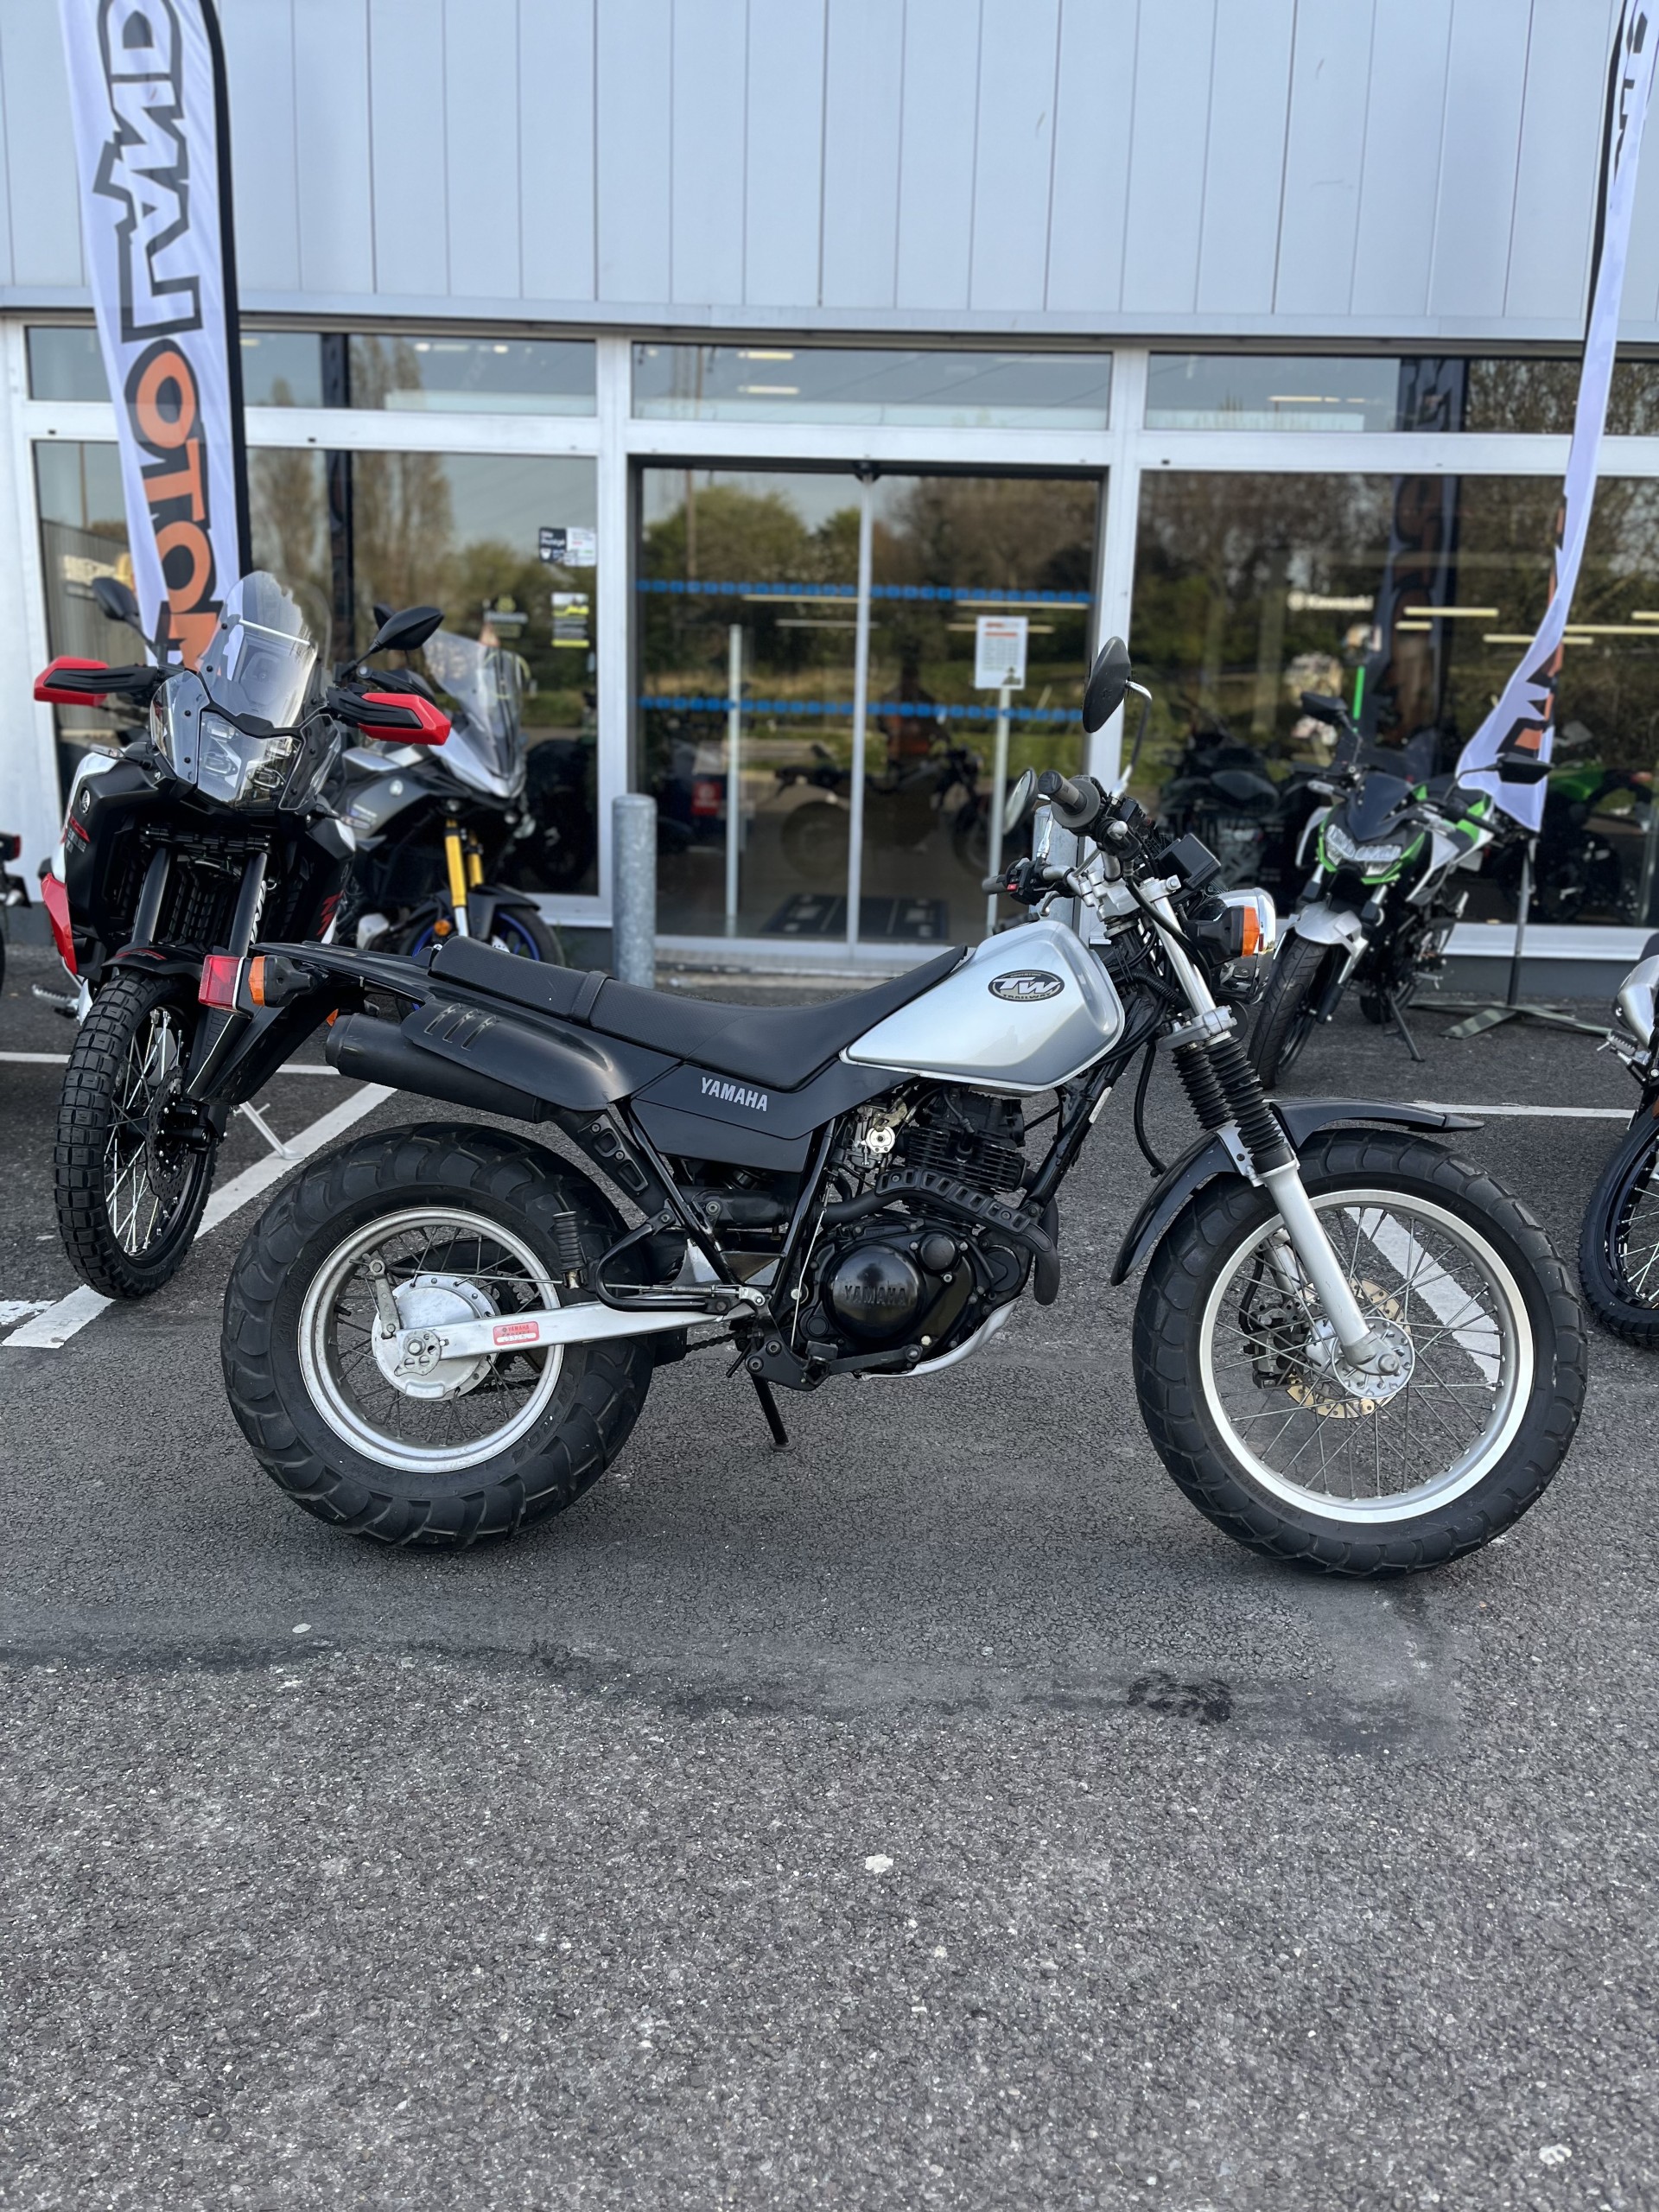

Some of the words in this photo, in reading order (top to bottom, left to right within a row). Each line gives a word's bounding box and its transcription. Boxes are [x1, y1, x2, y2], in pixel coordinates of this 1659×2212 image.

[993, 976, 1061, 995] TW
[701, 1077, 768, 1112] YAMAHA
[844, 1285, 906, 1306] YAMAHA
